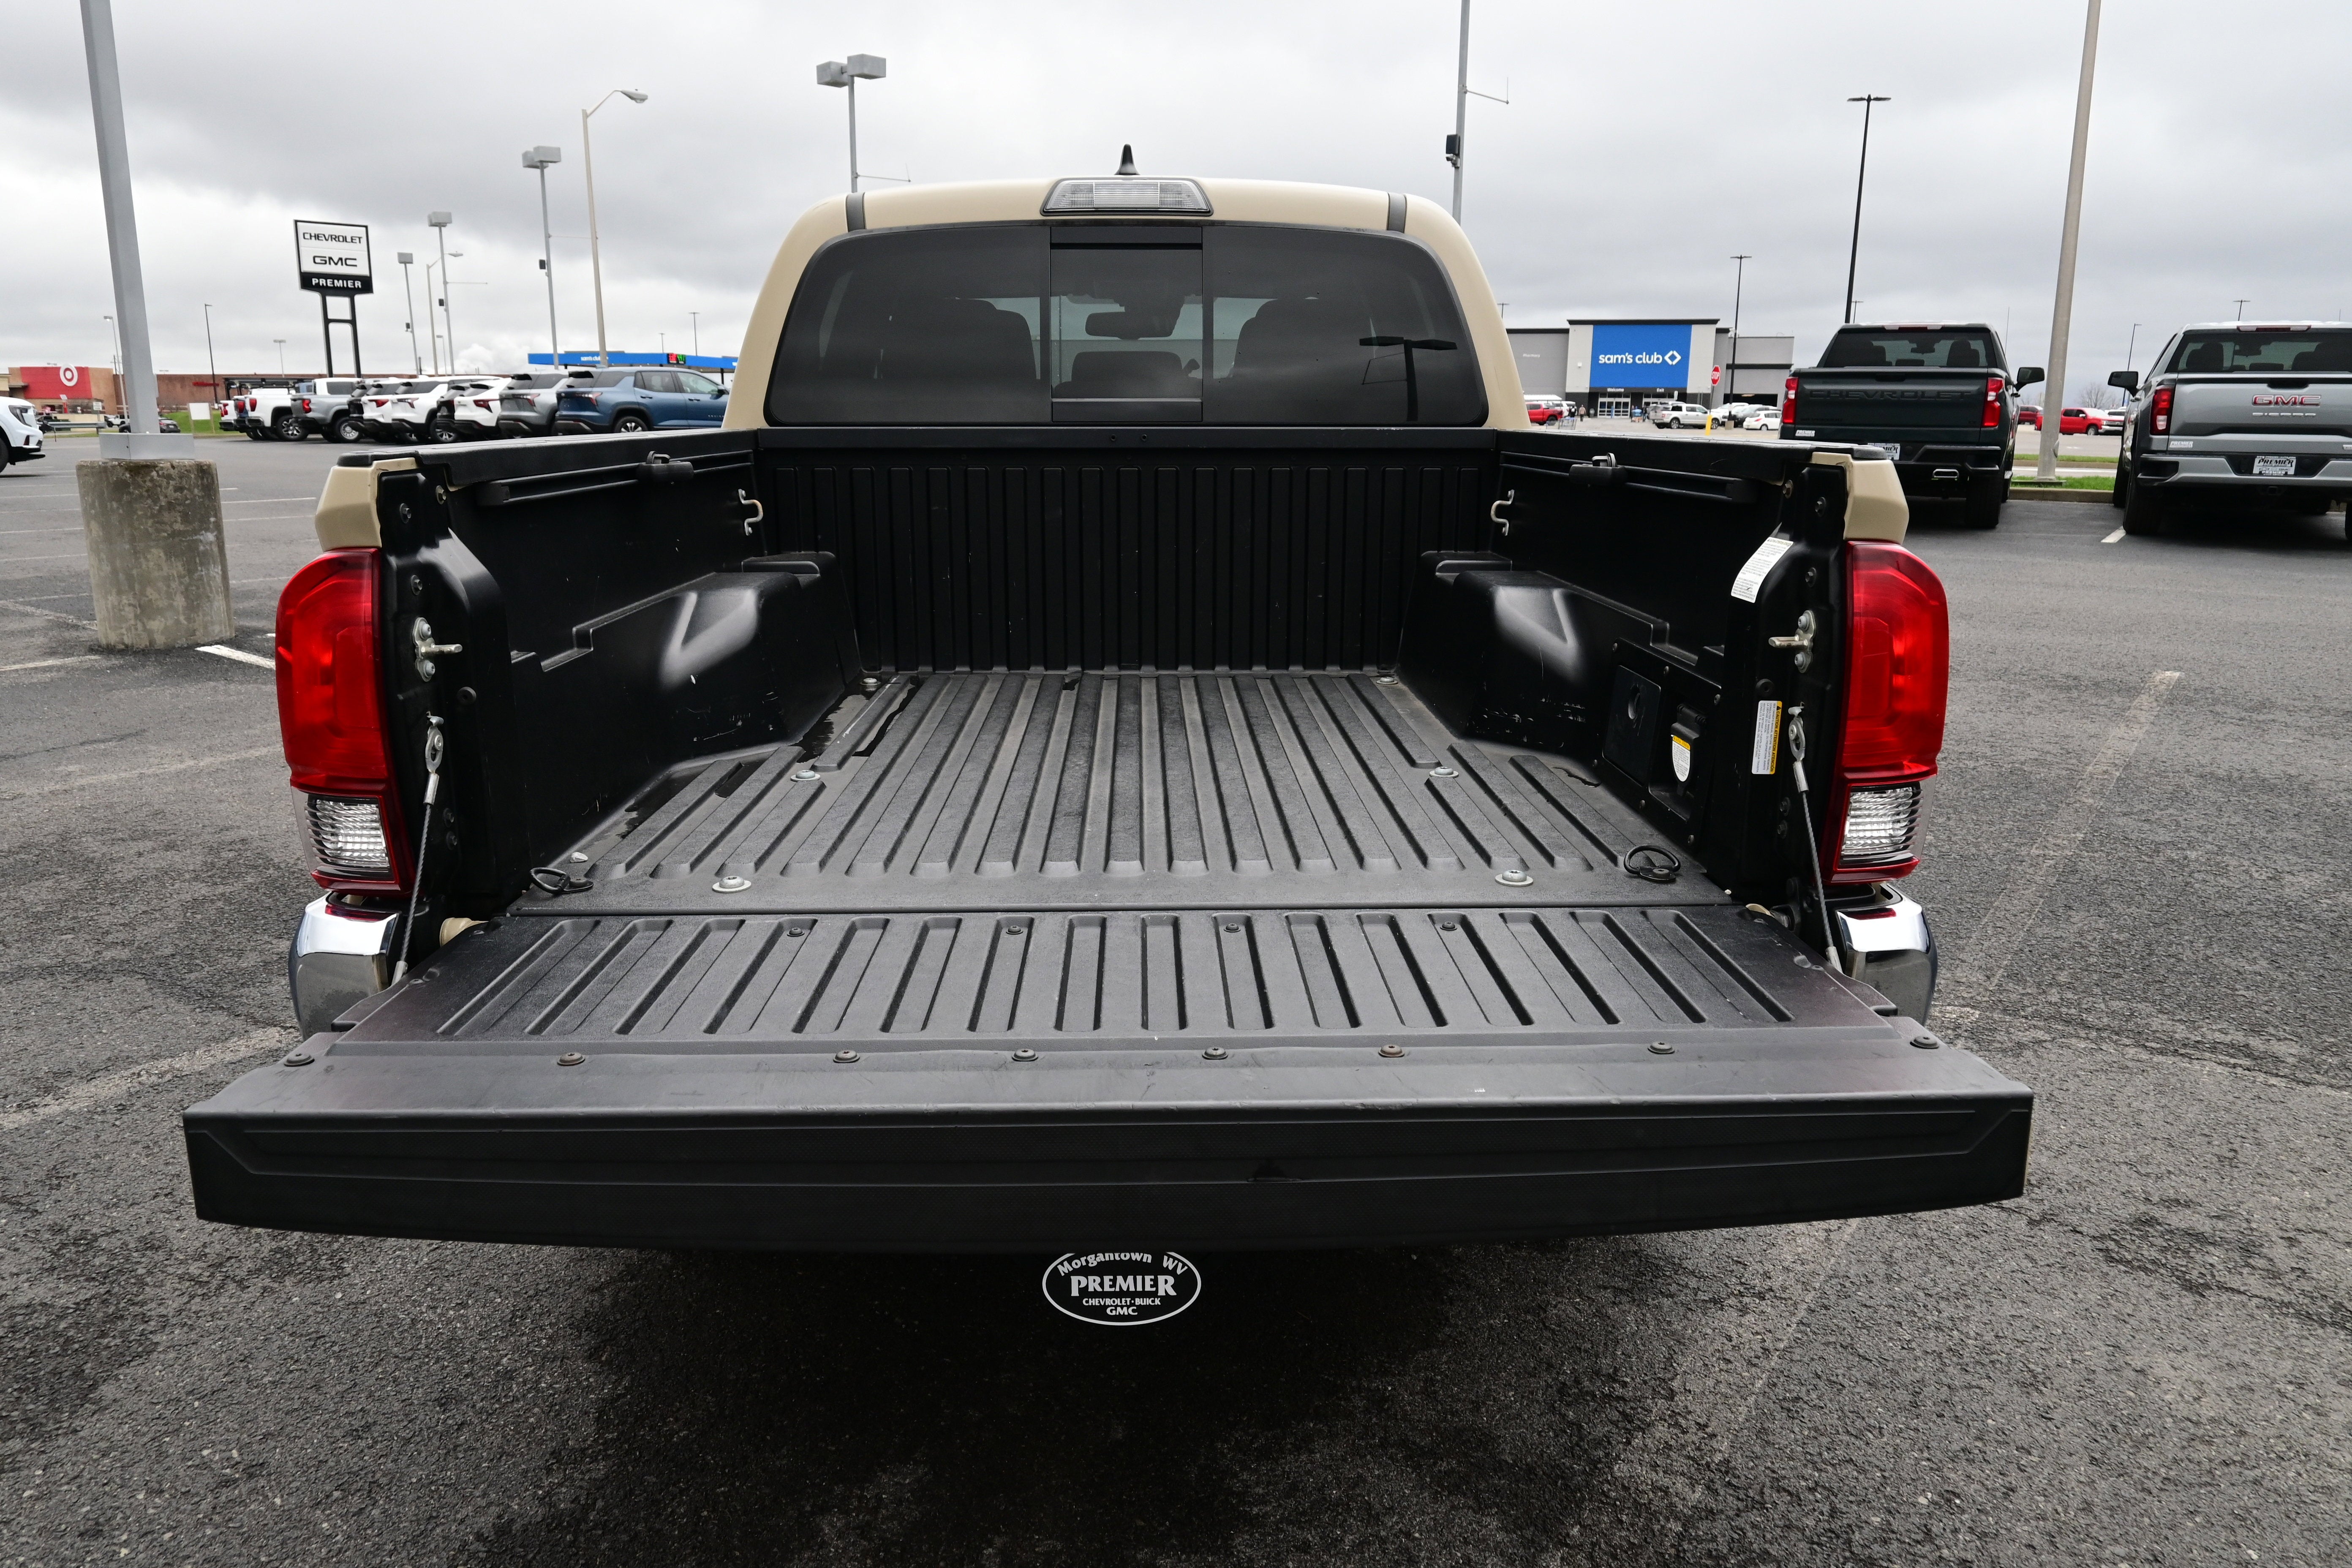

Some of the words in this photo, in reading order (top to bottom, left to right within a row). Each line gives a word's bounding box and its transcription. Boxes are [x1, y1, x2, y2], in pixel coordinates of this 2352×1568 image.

[303, 232, 362, 244] CHEVROLET
[313, 255, 357, 267] GMC
[312, 278, 362, 288] PREMIER
[1598, 352, 1633, 364] sam's
[1635, 352, 1662, 364] club
[1810, 390, 1971, 400] CHEVROLET
[2252, 395, 2322, 407] GMC
[2258, 458, 2294, 467] PREMIER
[1057, 1252, 1152, 1276] Morgantown
[1162, 1255, 1188, 1275] WV
[1070, 1275, 1177, 1296] PREMIER
[1083, 1298, 1131, 1306] CHEVROLET
[1135, 1298, 1161, 1306] BUICK
[1106, 1307, 1138, 1315] GMC
